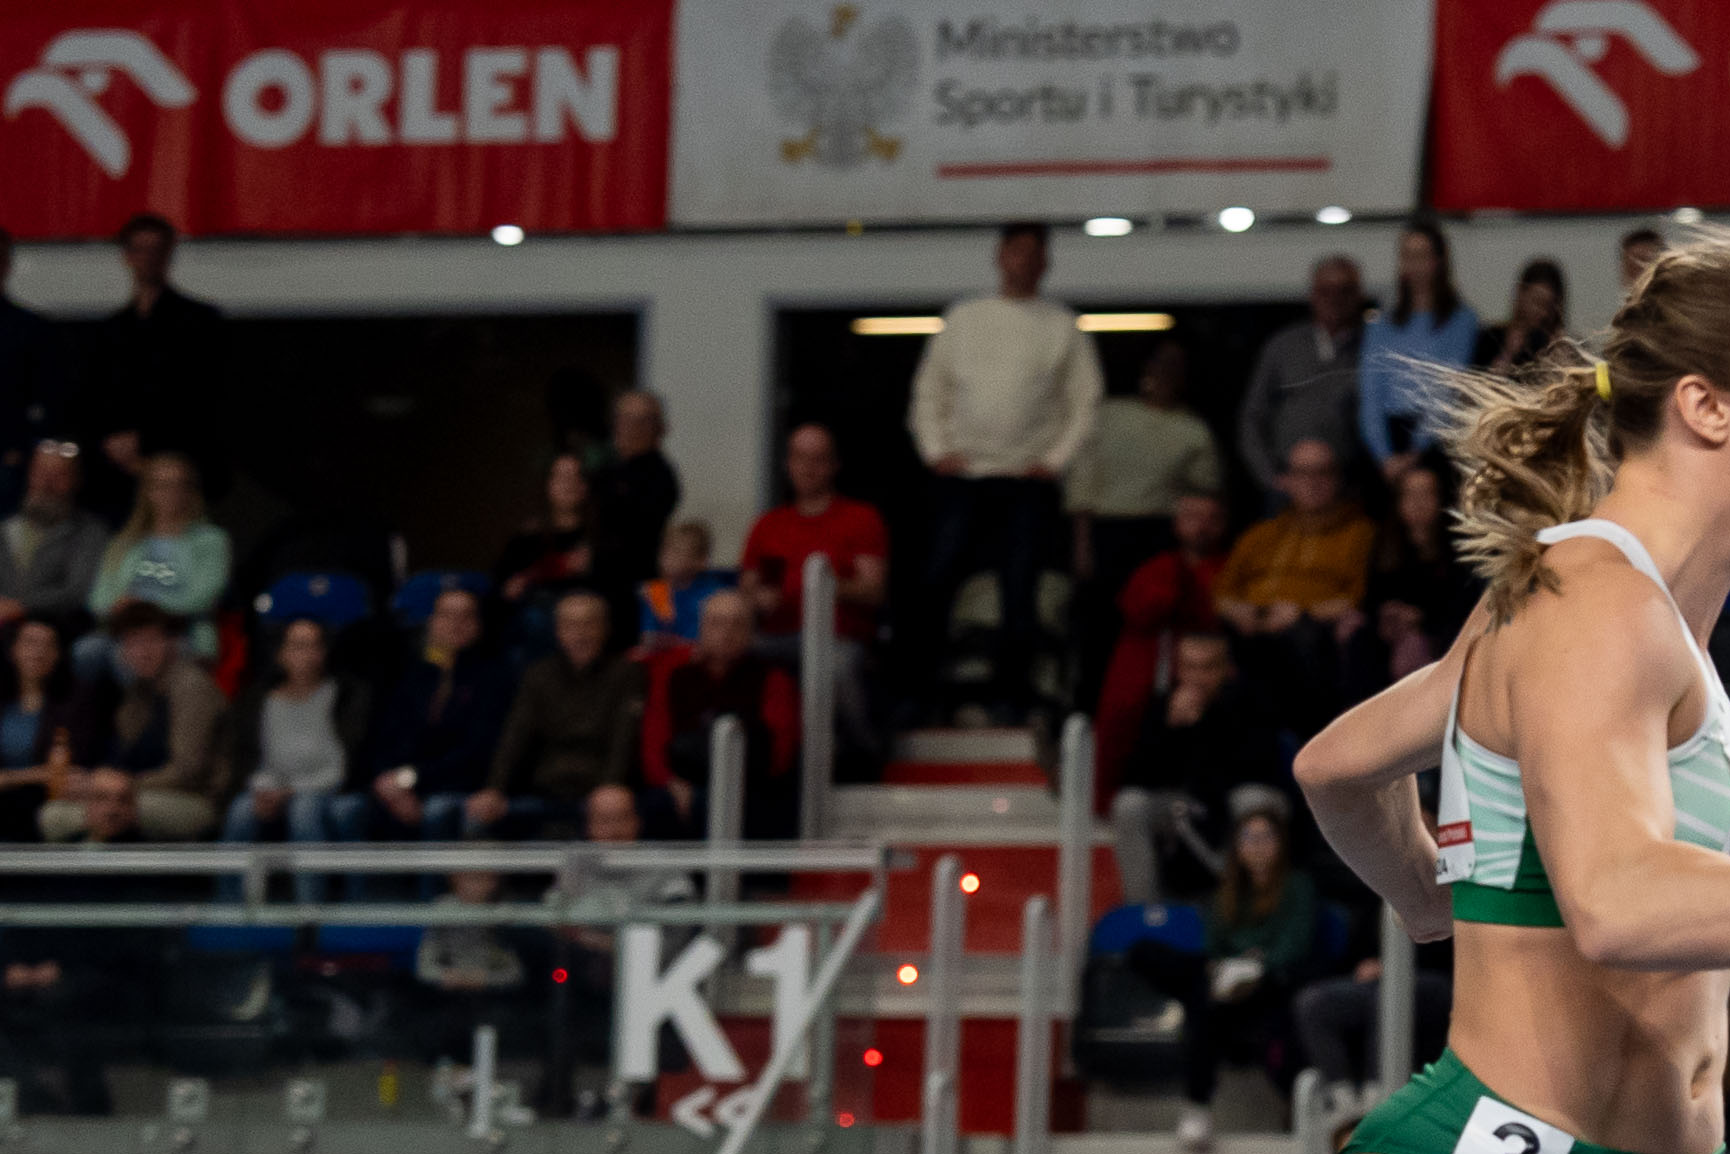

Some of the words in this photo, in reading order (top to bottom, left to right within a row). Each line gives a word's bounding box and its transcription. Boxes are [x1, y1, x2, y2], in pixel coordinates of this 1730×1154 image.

[222, 46, 618, 148] ORLEN
[933, 76, 1088, 127] Sportu
[1129, 68, 1341, 125] Turystyki
[617, 923, 811, 1083] K1
